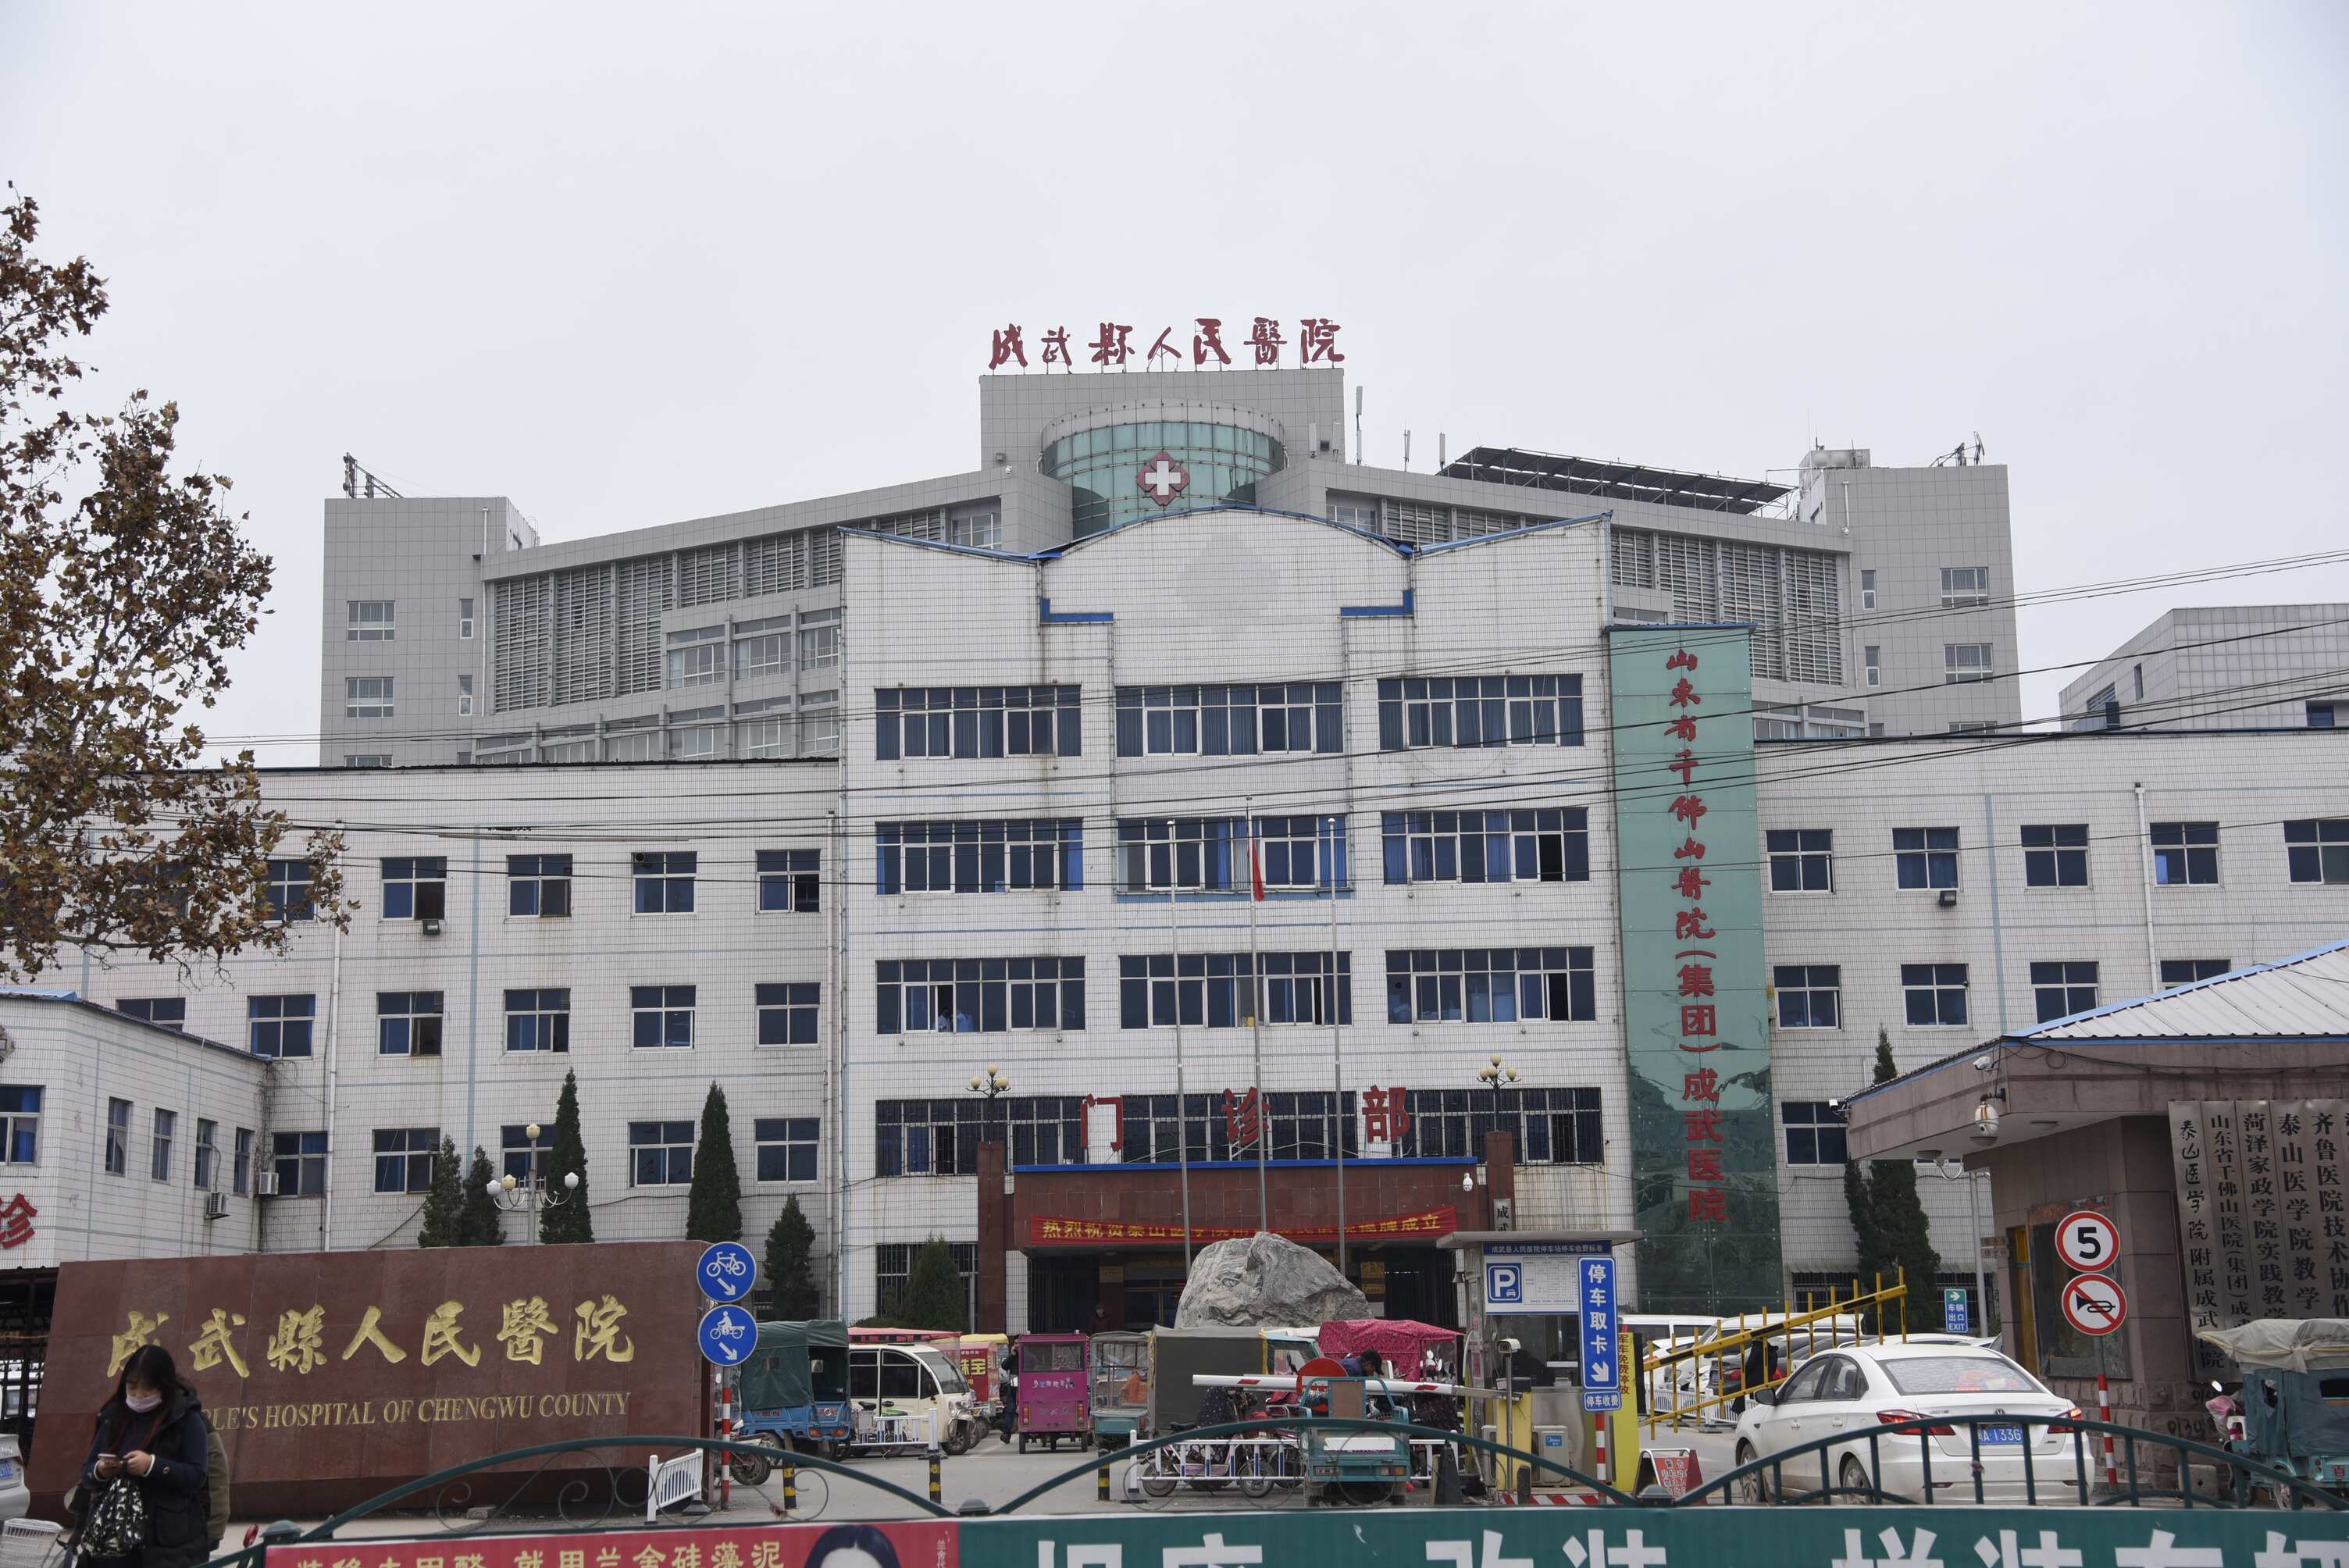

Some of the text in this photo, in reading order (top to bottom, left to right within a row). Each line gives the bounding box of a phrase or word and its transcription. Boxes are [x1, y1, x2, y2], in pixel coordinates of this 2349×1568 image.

[1081, 1085, 1410, 1151] 门诊部
[2279, 1113, 2321, 1318] 泰山医学院教学
[2077, 1227, 2101, 1259] 5
[2180, 1120, 2224, 1368] 泰山医学院附属成武院
[1494, 1269, 1516, 1297] P
[1588, 1264, 1608, 1354] 停车取卡
[264, 1401, 376, 1429] HOSPITAL
[384, 1400, 414, 1423] OF
[418, 1395, 536, 1423] CHENGWU
[539, 1392, 632, 1418] COUNTY
[1586, 1395, 1620, 1407] 停车收费
